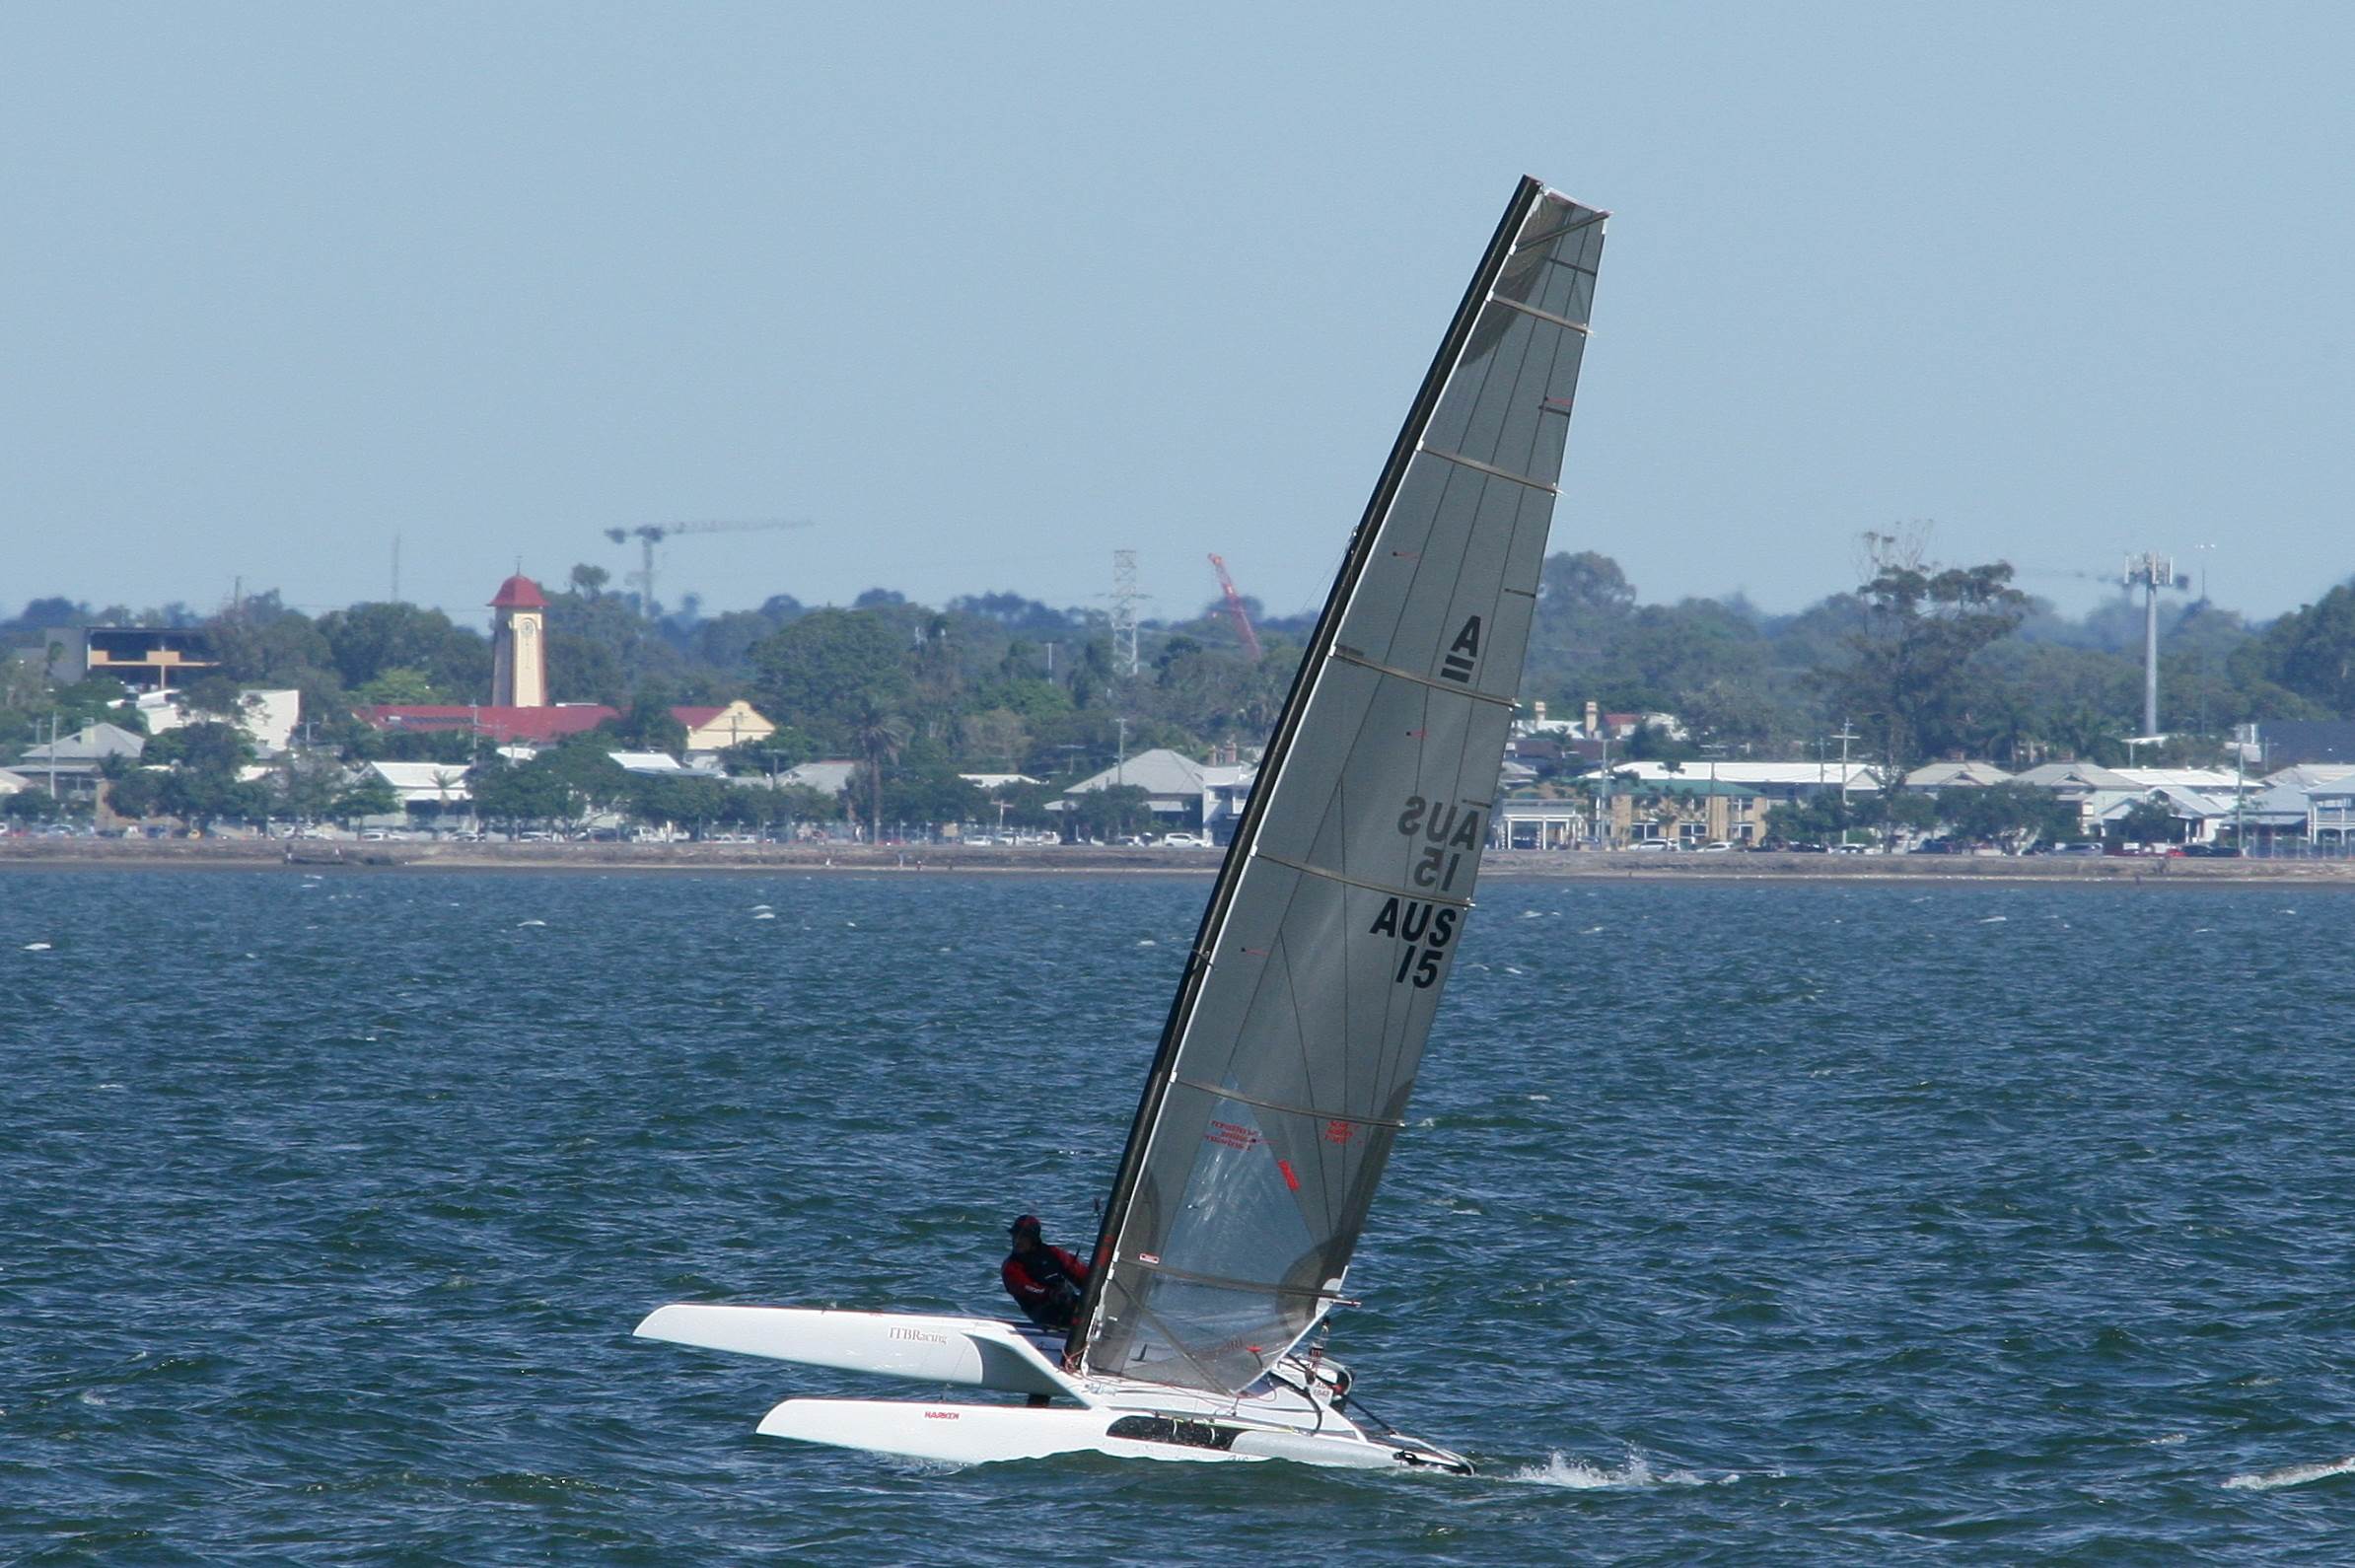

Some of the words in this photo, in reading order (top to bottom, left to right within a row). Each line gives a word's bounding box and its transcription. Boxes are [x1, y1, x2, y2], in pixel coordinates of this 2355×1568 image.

[1450, 614, 1481, 659] A
[1369, 896, 1458, 949] AUS
[1394, 944, 1445, 989] 15
